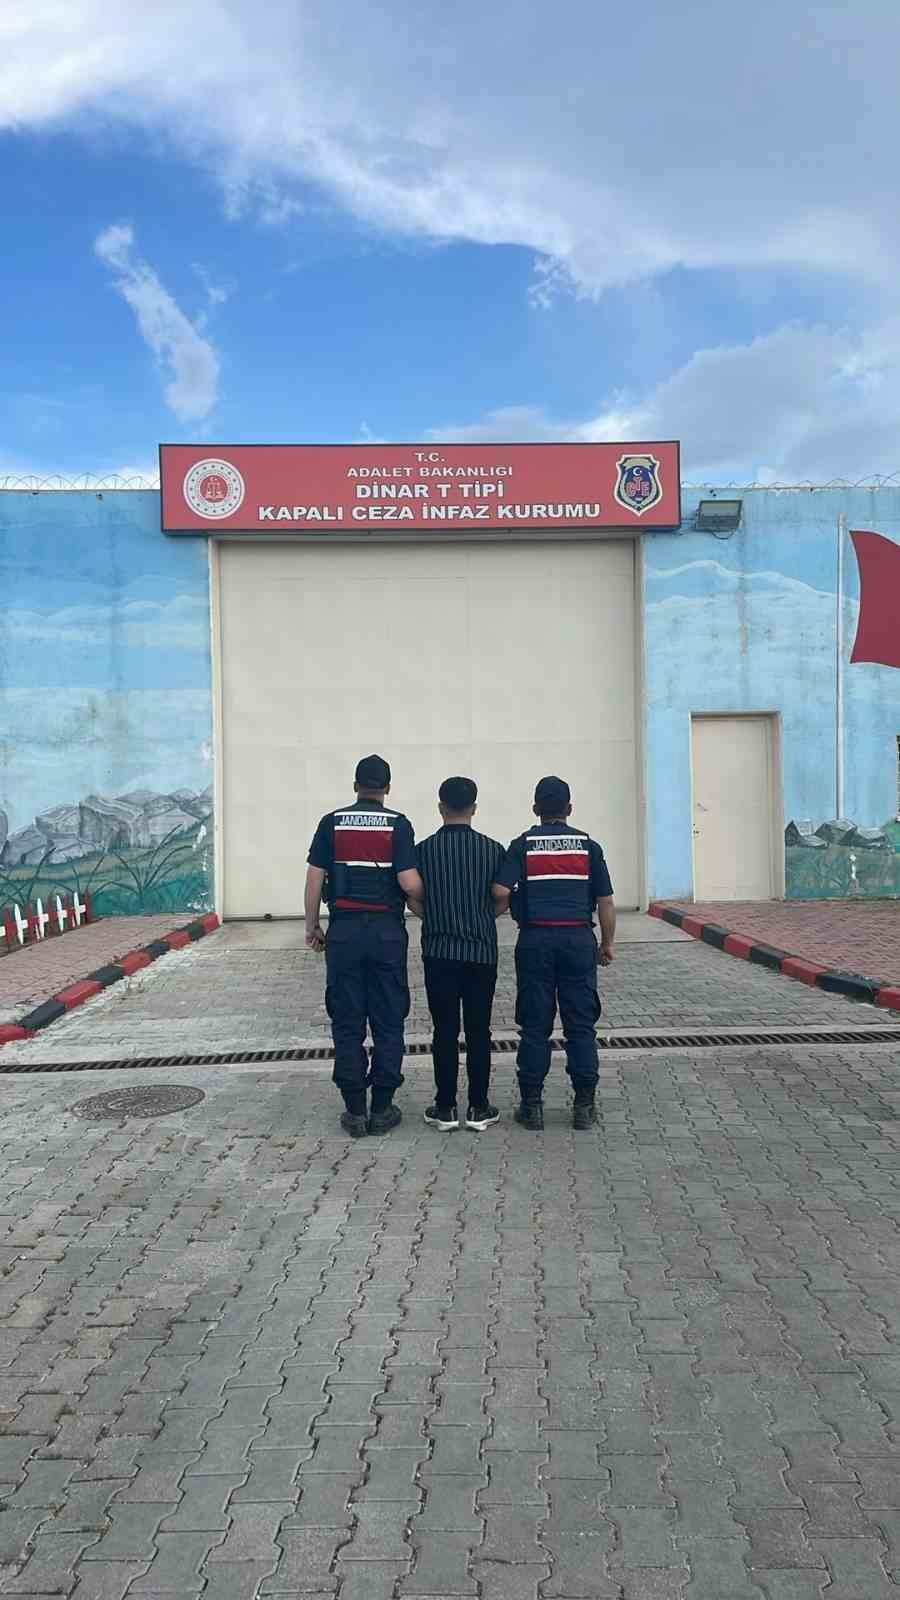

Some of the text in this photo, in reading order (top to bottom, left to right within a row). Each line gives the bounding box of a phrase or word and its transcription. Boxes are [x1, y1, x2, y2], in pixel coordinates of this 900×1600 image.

[415, 452, 446, 463] T.C.
[347, 466, 414, 478] ADALET
[356, 480, 505, 499] DİNAR T TİPİ
[258, 502, 601, 521] KAPALI CEZA İNFAZ KURUMU
[339, 815, 389, 826] JANDARMA
[532, 839, 584, 851] JANDARMA
